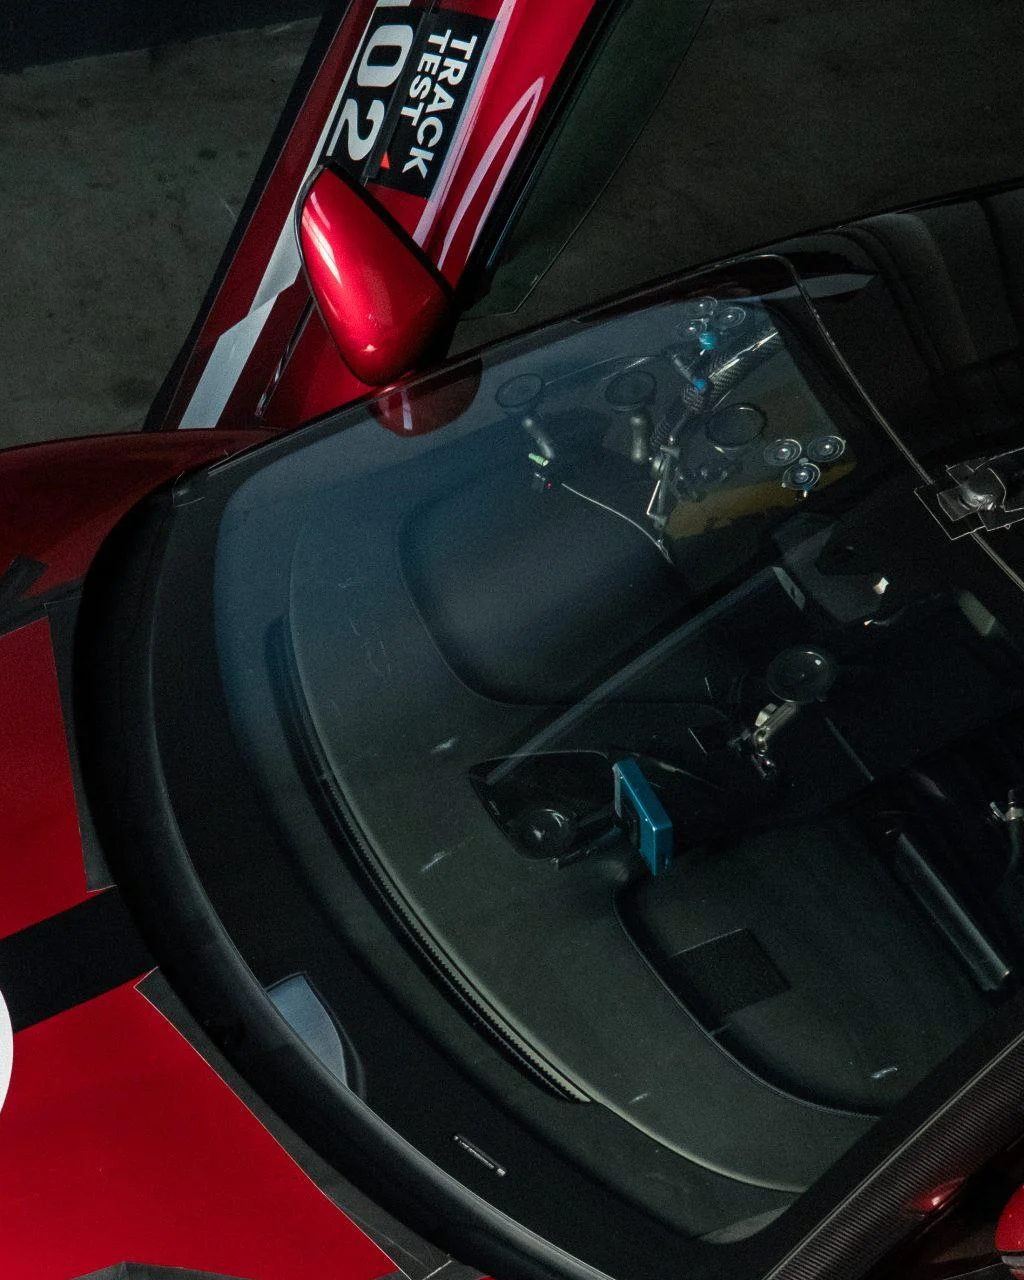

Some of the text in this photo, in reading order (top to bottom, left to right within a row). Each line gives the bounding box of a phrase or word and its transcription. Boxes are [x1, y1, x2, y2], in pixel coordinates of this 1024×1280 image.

[326, 0, 414, 162] 02
[400, 29, 451, 126] TEST
[402, 35, 477, 179] TRACK
